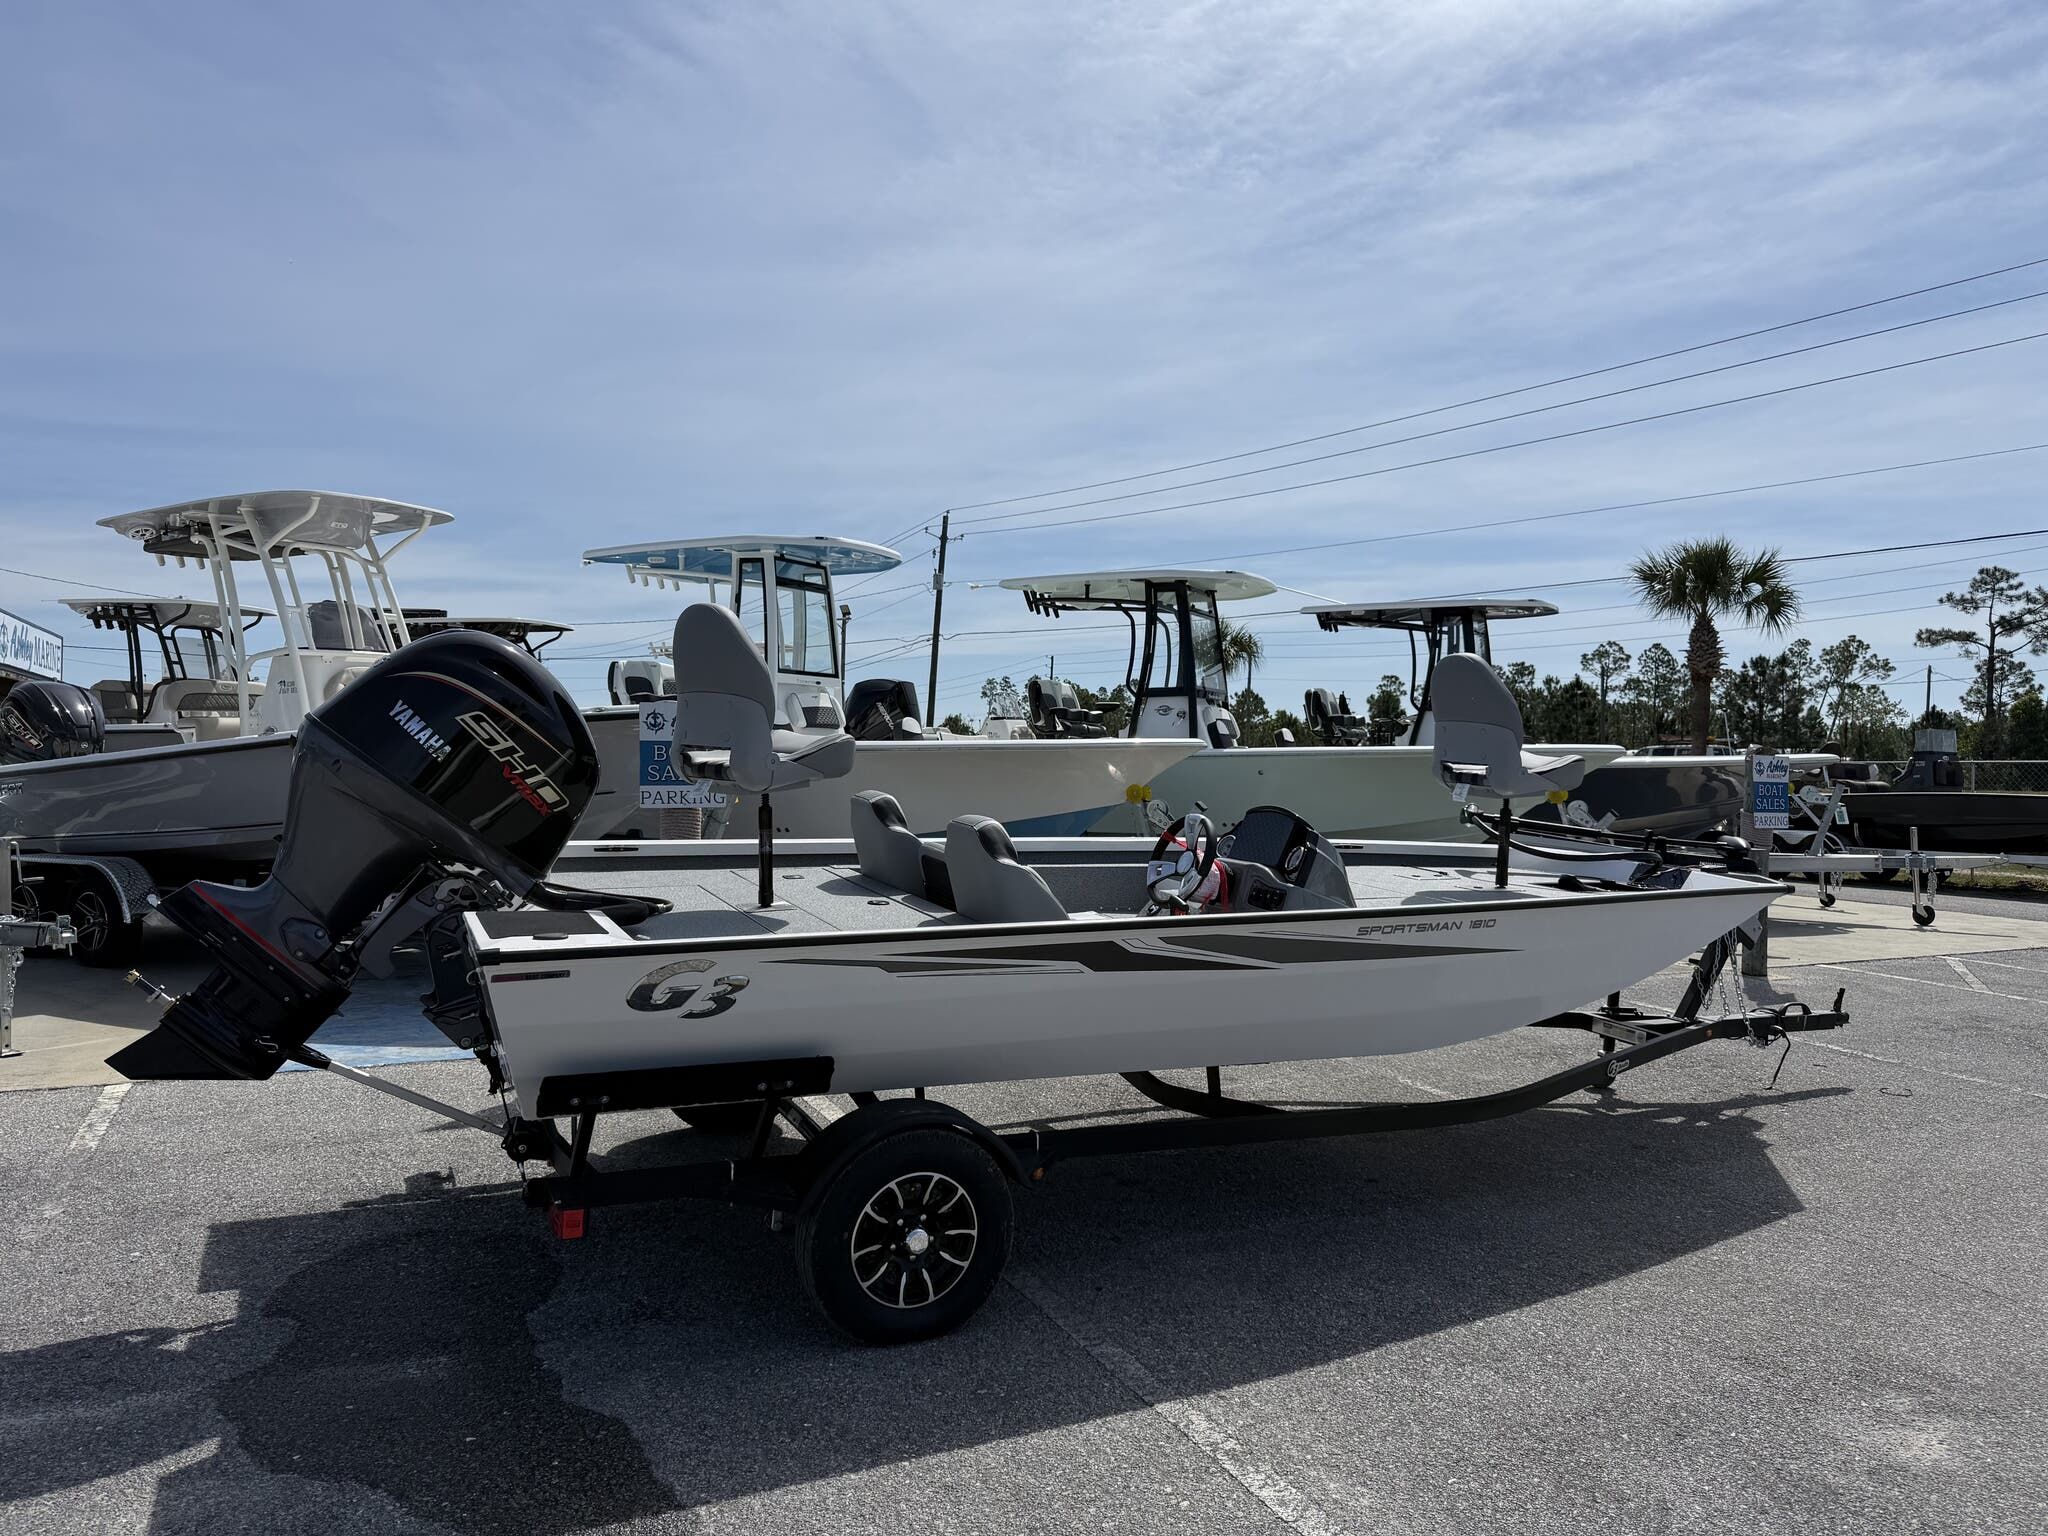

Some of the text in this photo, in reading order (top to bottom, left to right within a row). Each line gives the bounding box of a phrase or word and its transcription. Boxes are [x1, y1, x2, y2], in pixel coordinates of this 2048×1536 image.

[33, 635, 61, 674] MARINE
[388, 699, 451, 764] YAMAHA
[455, 711, 570, 812] SHO
[1767, 757, 1788, 777] Ashley
[640, 790, 726, 805] PARKING
[1759, 784, 1783, 796] BOAT
[1756, 798, 1785, 810] SALES
[1754, 815, 1788, 826] PARKING
[1356, 918, 1497, 936] SPORTSMAN 1810
[625, 958, 750, 1019] G3
